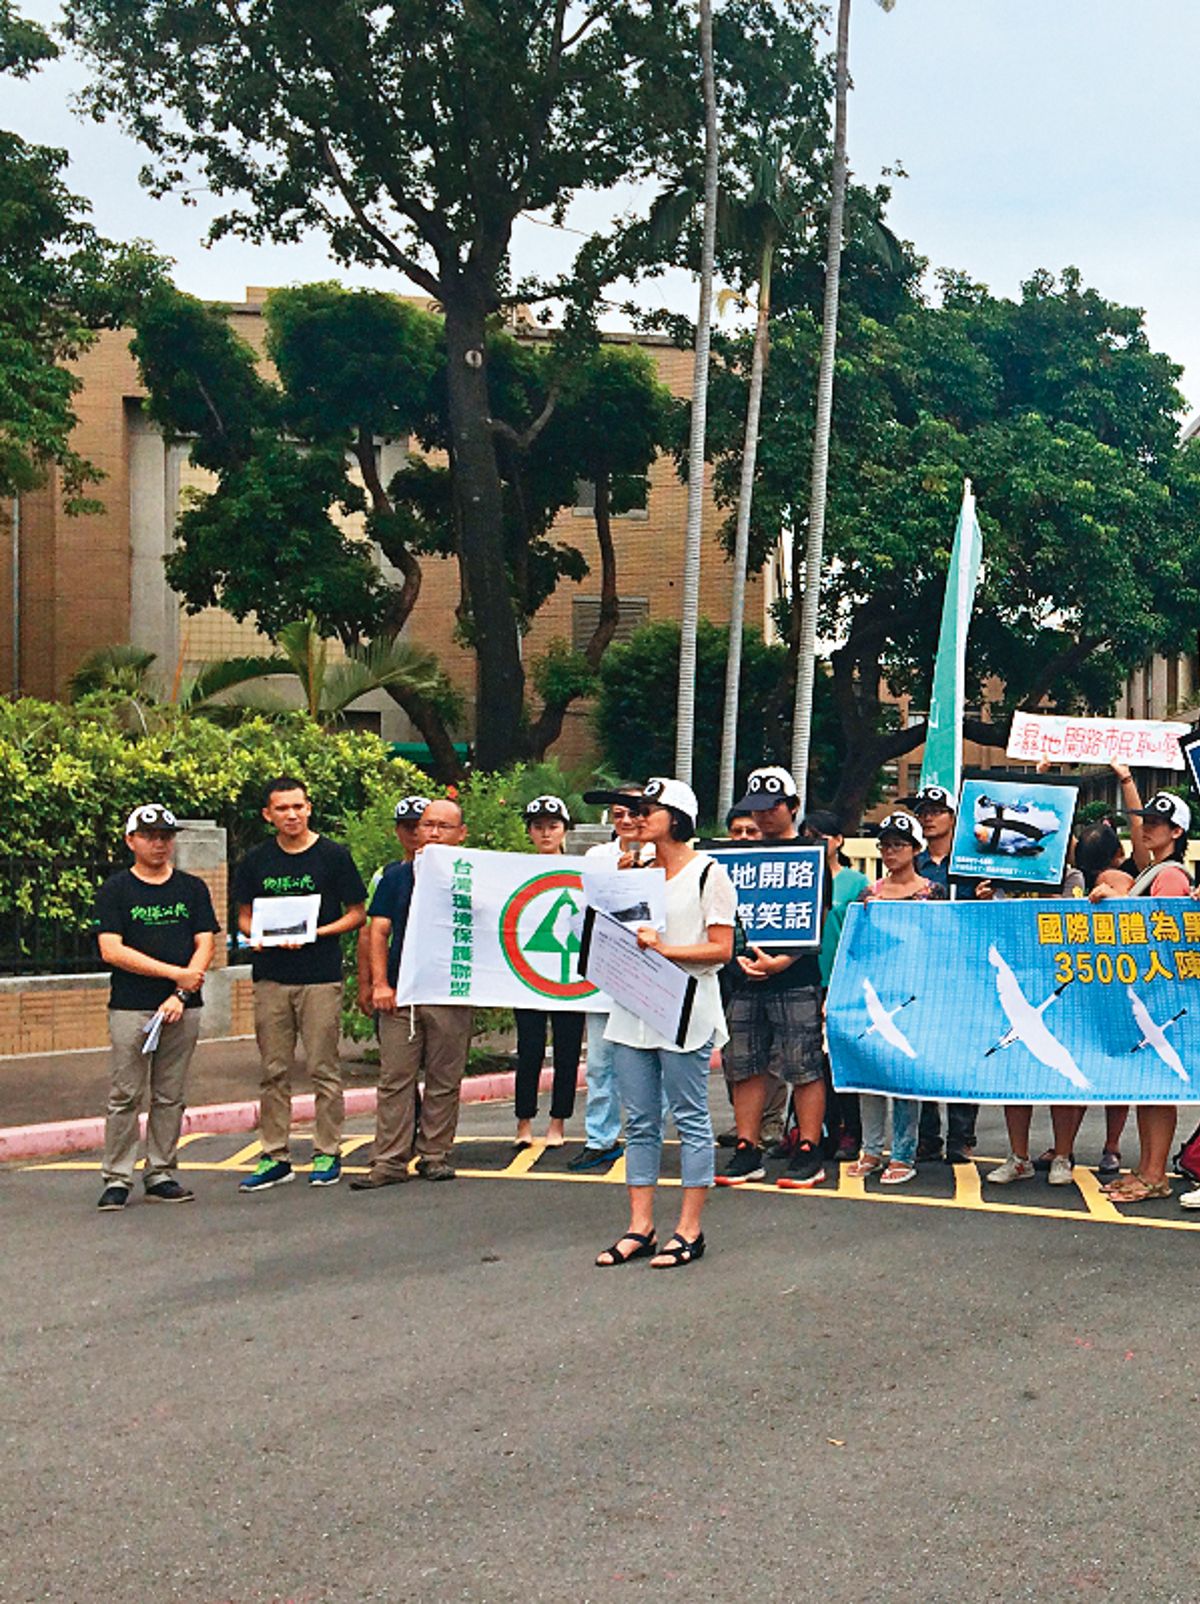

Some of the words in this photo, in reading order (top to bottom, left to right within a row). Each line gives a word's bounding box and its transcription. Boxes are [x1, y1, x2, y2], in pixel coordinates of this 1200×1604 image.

[731, 860, 815, 889] 地開路
[449, 857, 474, 998] 台灣環境保護聯盟
[738, 902, 814, 930] 際笑話
